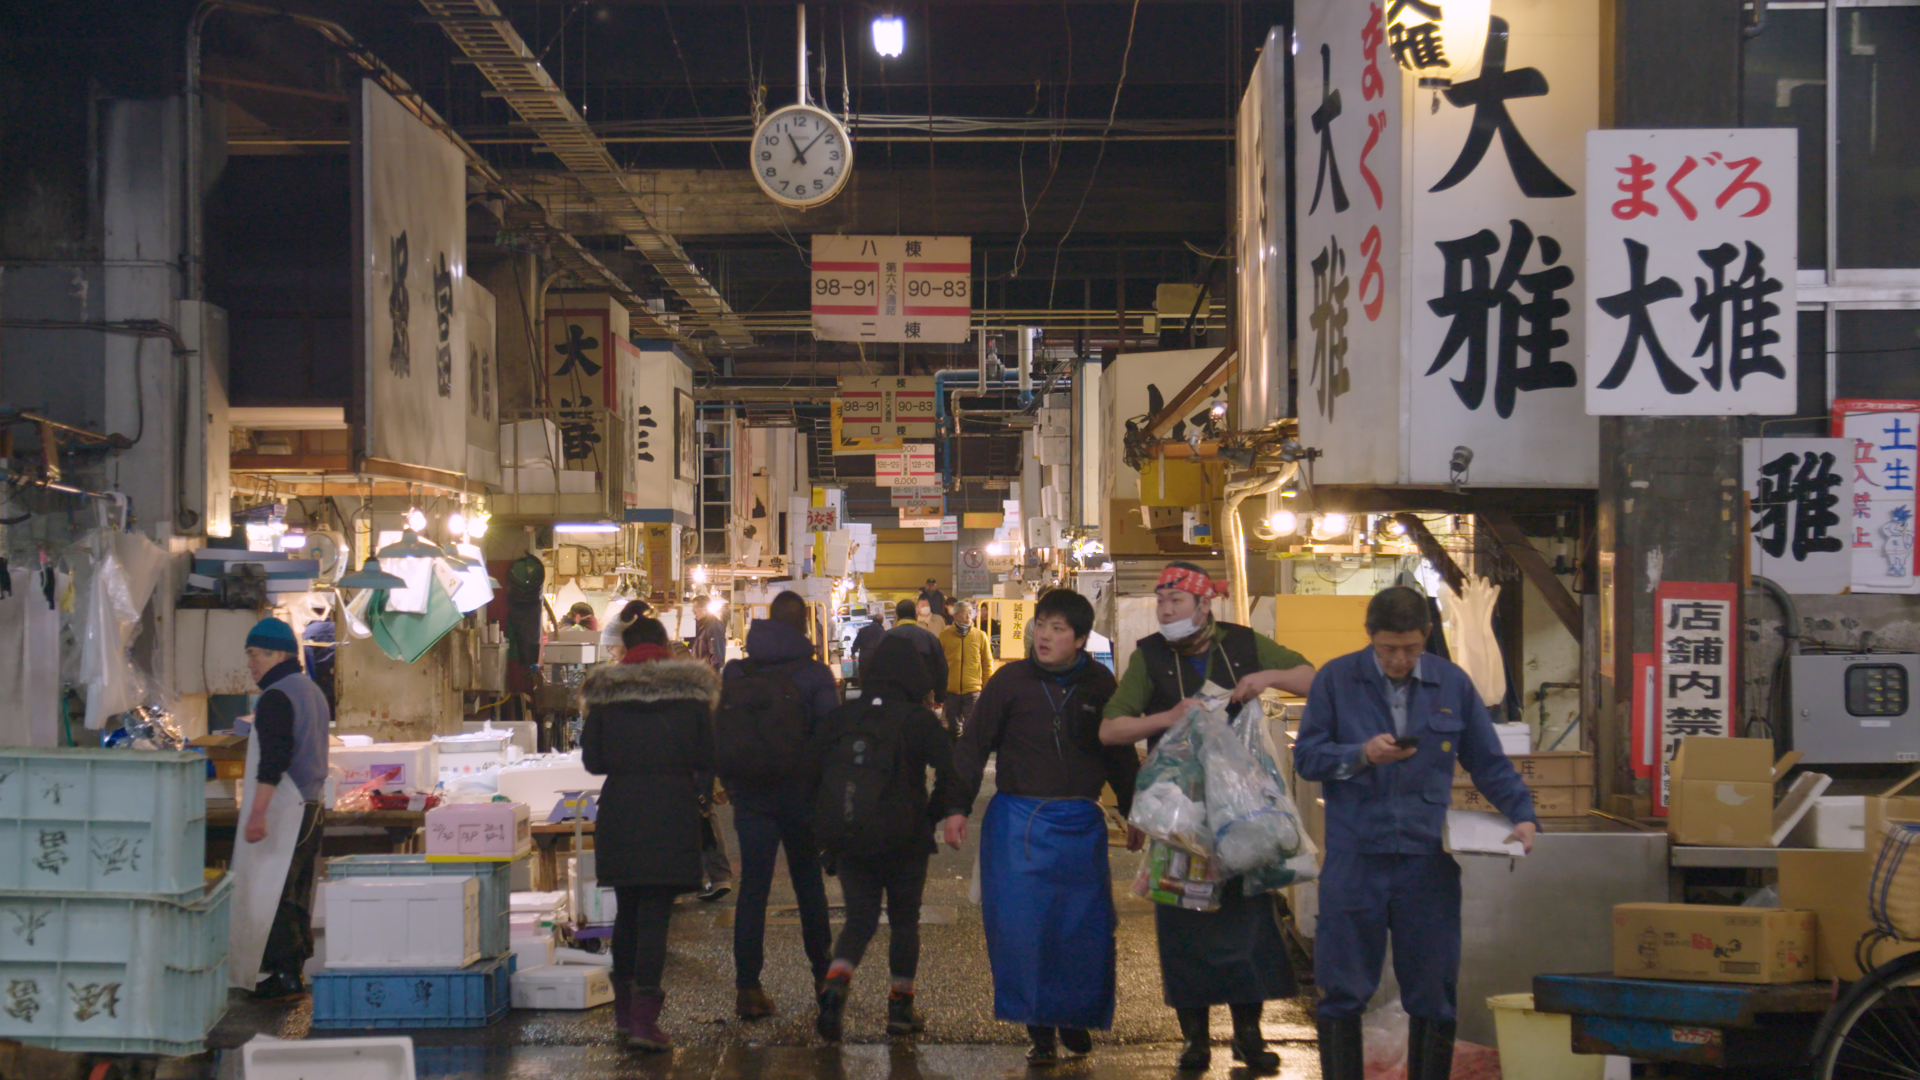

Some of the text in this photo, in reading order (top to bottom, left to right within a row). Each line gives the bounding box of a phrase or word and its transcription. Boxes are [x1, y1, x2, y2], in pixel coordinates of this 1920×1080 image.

[776, 123, 788, 133] 11
[793, 117, 807, 127] 12
[765, 136, 779, 146] 10
[825, 134, 835, 144] 2
[761, 151, 772, 161] 9
[829, 151, 840, 160] 3
[1359, 2, 1386, 322] まぐろ
[765, 167, 777, 177] 8
[823, 166, 835, 176] 4
[779, 181, 790, 191] 7
[795, 185, 806, 195] 6
[813, 179, 824, 190] 5
[1611, 152, 1772, 221] まぐろ
[1425, 14, 1577, 419] 大雅
[1309, 44, 1351, 423] 大雅
[815, 279, 875, 296] 98-91
[885, 262, 897, 316] 第六大通路
[908, 280, 967, 297] 90-83
[1596, 237, 1788, 396] 大雅
[844, 401, 879, 411] 98-91
[898, 401, 933, 411] 90-83
[1879, 418, 1917, 491] 土生
[877, 461, 900, 469] 136-129
[1852, 438, 1881, 548] 立入禁止
[1750, 451, 1843, 562] 雅
[807, 511, 835, 526] うなぎ
[1012, 603, 1022, 640] 誠和水産
[1666, 602, 1724, 761] 店舗内禁
